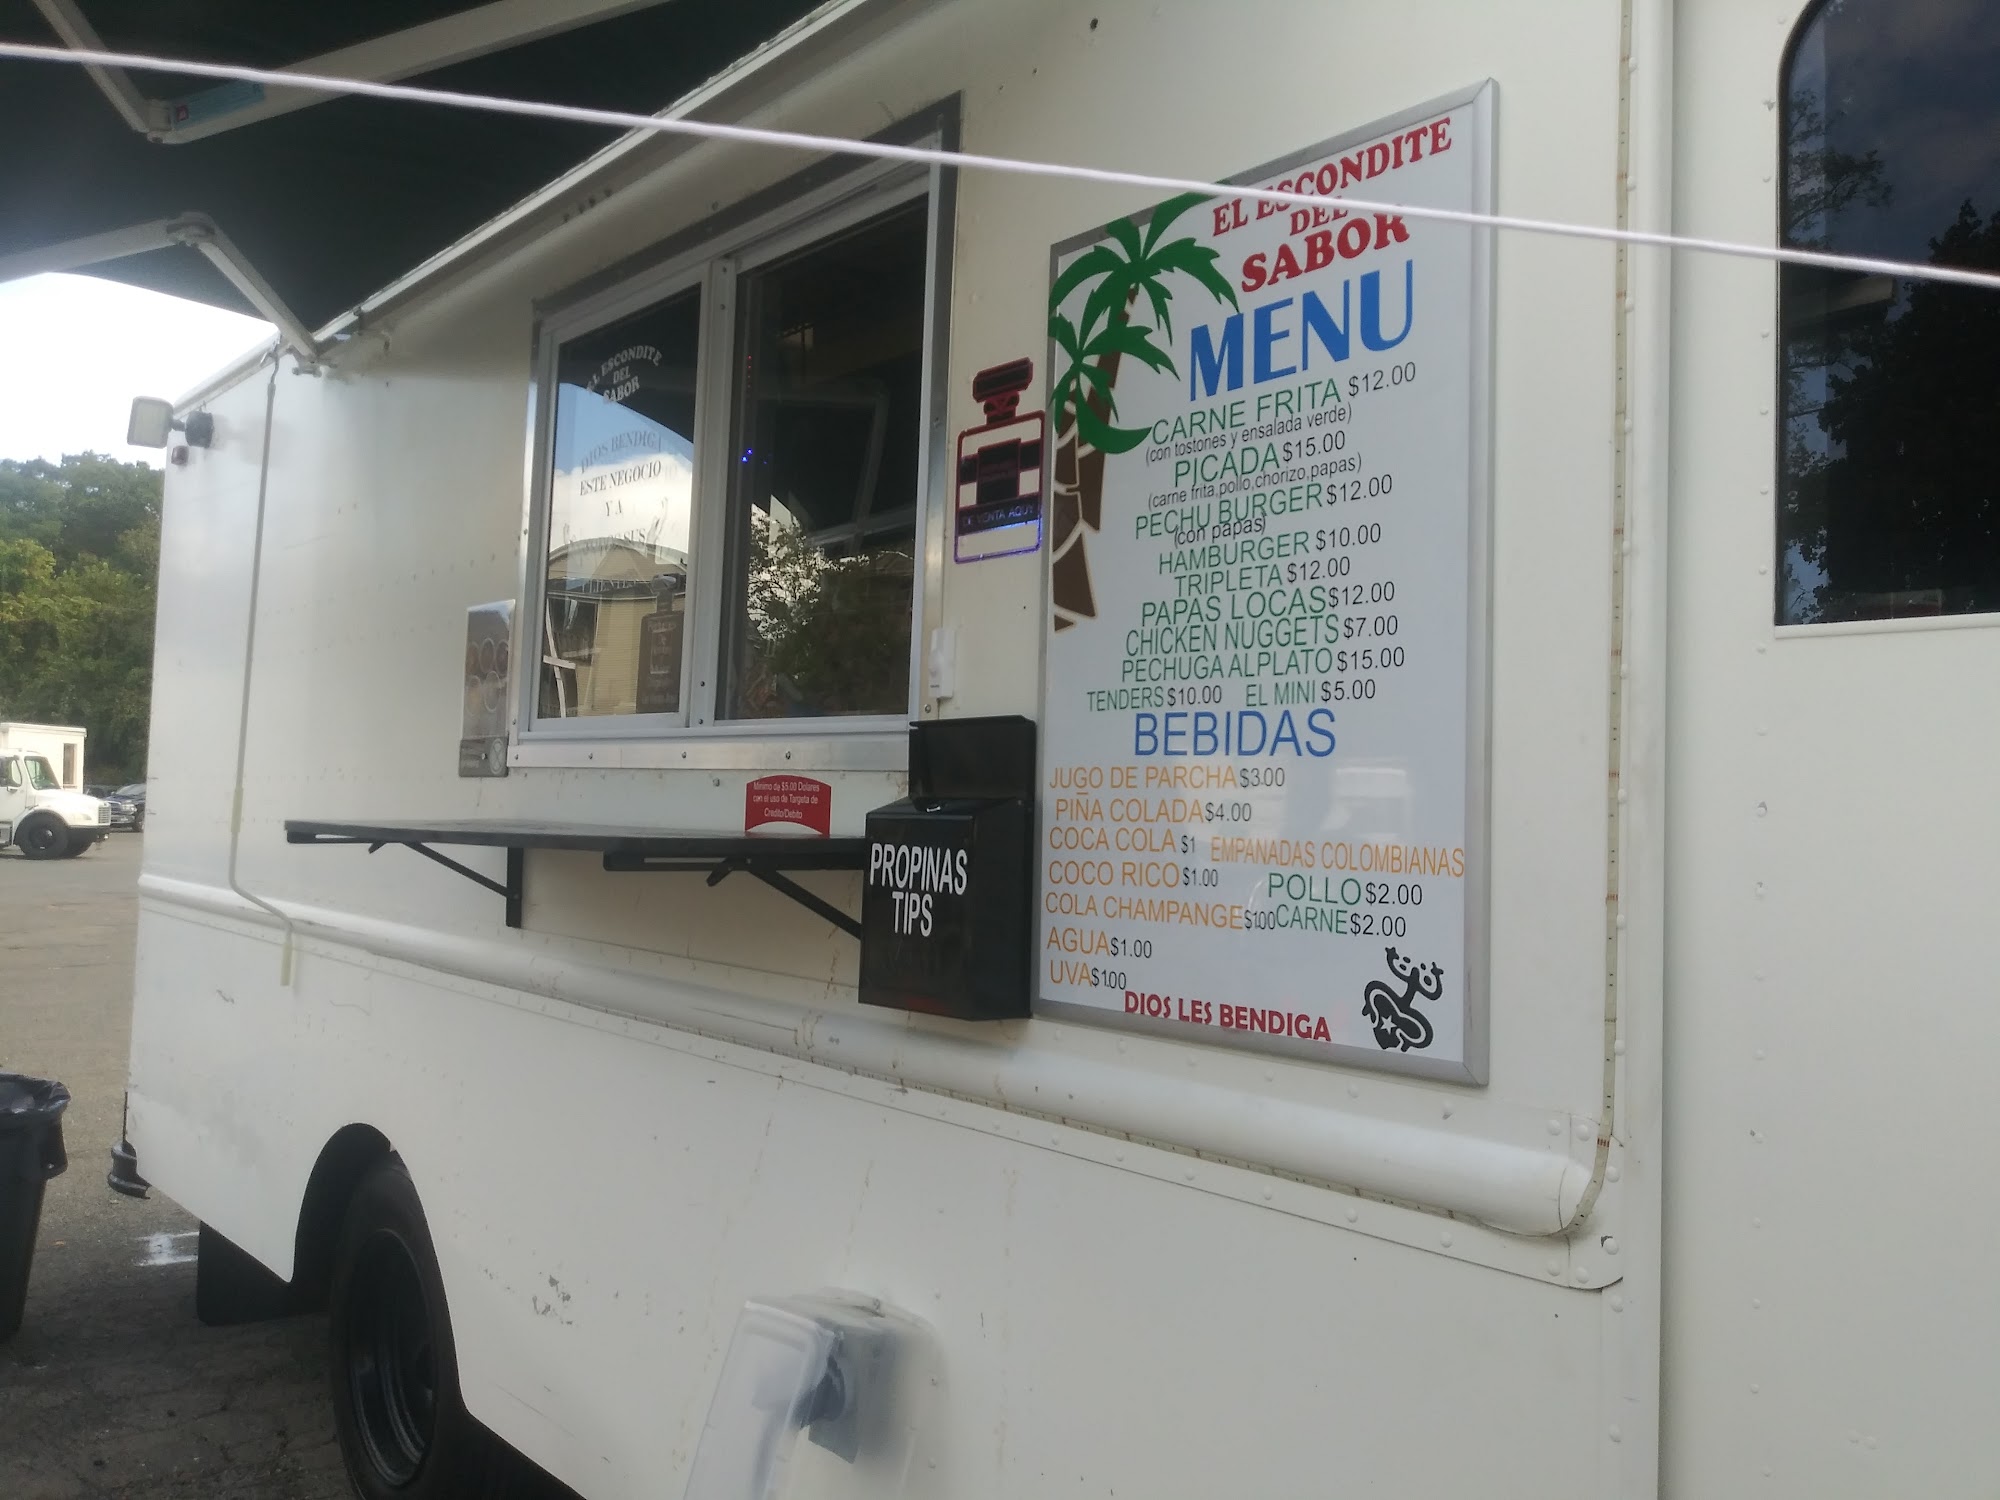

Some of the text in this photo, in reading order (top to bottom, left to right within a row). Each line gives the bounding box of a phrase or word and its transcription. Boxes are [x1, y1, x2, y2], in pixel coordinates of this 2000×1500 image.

[1213, 117, 1452, 236] EL ESCONDITE
[1290, 195, 1348, 236] DEL
[1241, 205, 1410, 293] SABOR
[1190, 259, 1413, 401] MENU
[601, 345, 663, 376] ESCONDITE
[613, 365, 630, 384] DEL
[1152, 361, 1416, 445] CARNE FRITA $12.00
[1146, 402, 1353, 468] (con tostones y ensalada verde)
[580, 460, 662, 496] ESTE NEGOCIO
[1175, 430, 1346, 487] PICADA $15.00
[1135, 474, 1393, 540] PECHU BURGER $12.00
[1149, 491, 1187, 512] (carne
[1159, 522, 1382, 575] HAMBURGER $10.00
[1174, 512, 1267, 549] (con papas)
[1174, 556, 1351, 597] TRIPLETA $12.00
[1142, 581, 1396, 627] PAPAS LOCAS $12.00
[1126, 613, 1399, 657] CHICKEN NUGGETS $7.00
[1122, 653, 1225, 683] PECHUGA
[1336, 646, 1405, 674] $15.00
[1087, 684, 1223, 712] TENDERS $10.00
[1245, 678, 1376, 707] EL MINI $5.00
[1135, 708, 1337, 758] BEBIDAS
[1049, 766, 1105, 789] JUGO
[1110, 766, 1138, 789] DE
[1145, 765, 1238, 789] PARCHA
[1055, 791, 1252, 824] PIÑA COLADA $4.00
[1049, 826, 1196, 854] COCA COLA $1
[1210, 836, 1465, 878] EMPANADAS COLOMBIANAS
[869, 842, 968, 896] PROPINAS
[1048, 859, 1219, 888] COCO RICO $1.00
[1267, 872, 1423, 906] POLLO $2.00
[892, 891, 933, 938] TIPS
[1044, 891, 1098, 917] COLA
[1102, 895, 1243, 931] CHAMPANGE
[1276, 903, 1407, 938] CARNE $2.00
[1046, 926, 1153, 959] AGUA $1.00
[1049, 959, 1092, 987] UVA
[1123, 990, 1332, 1042] DIOS LES BENDIGA
